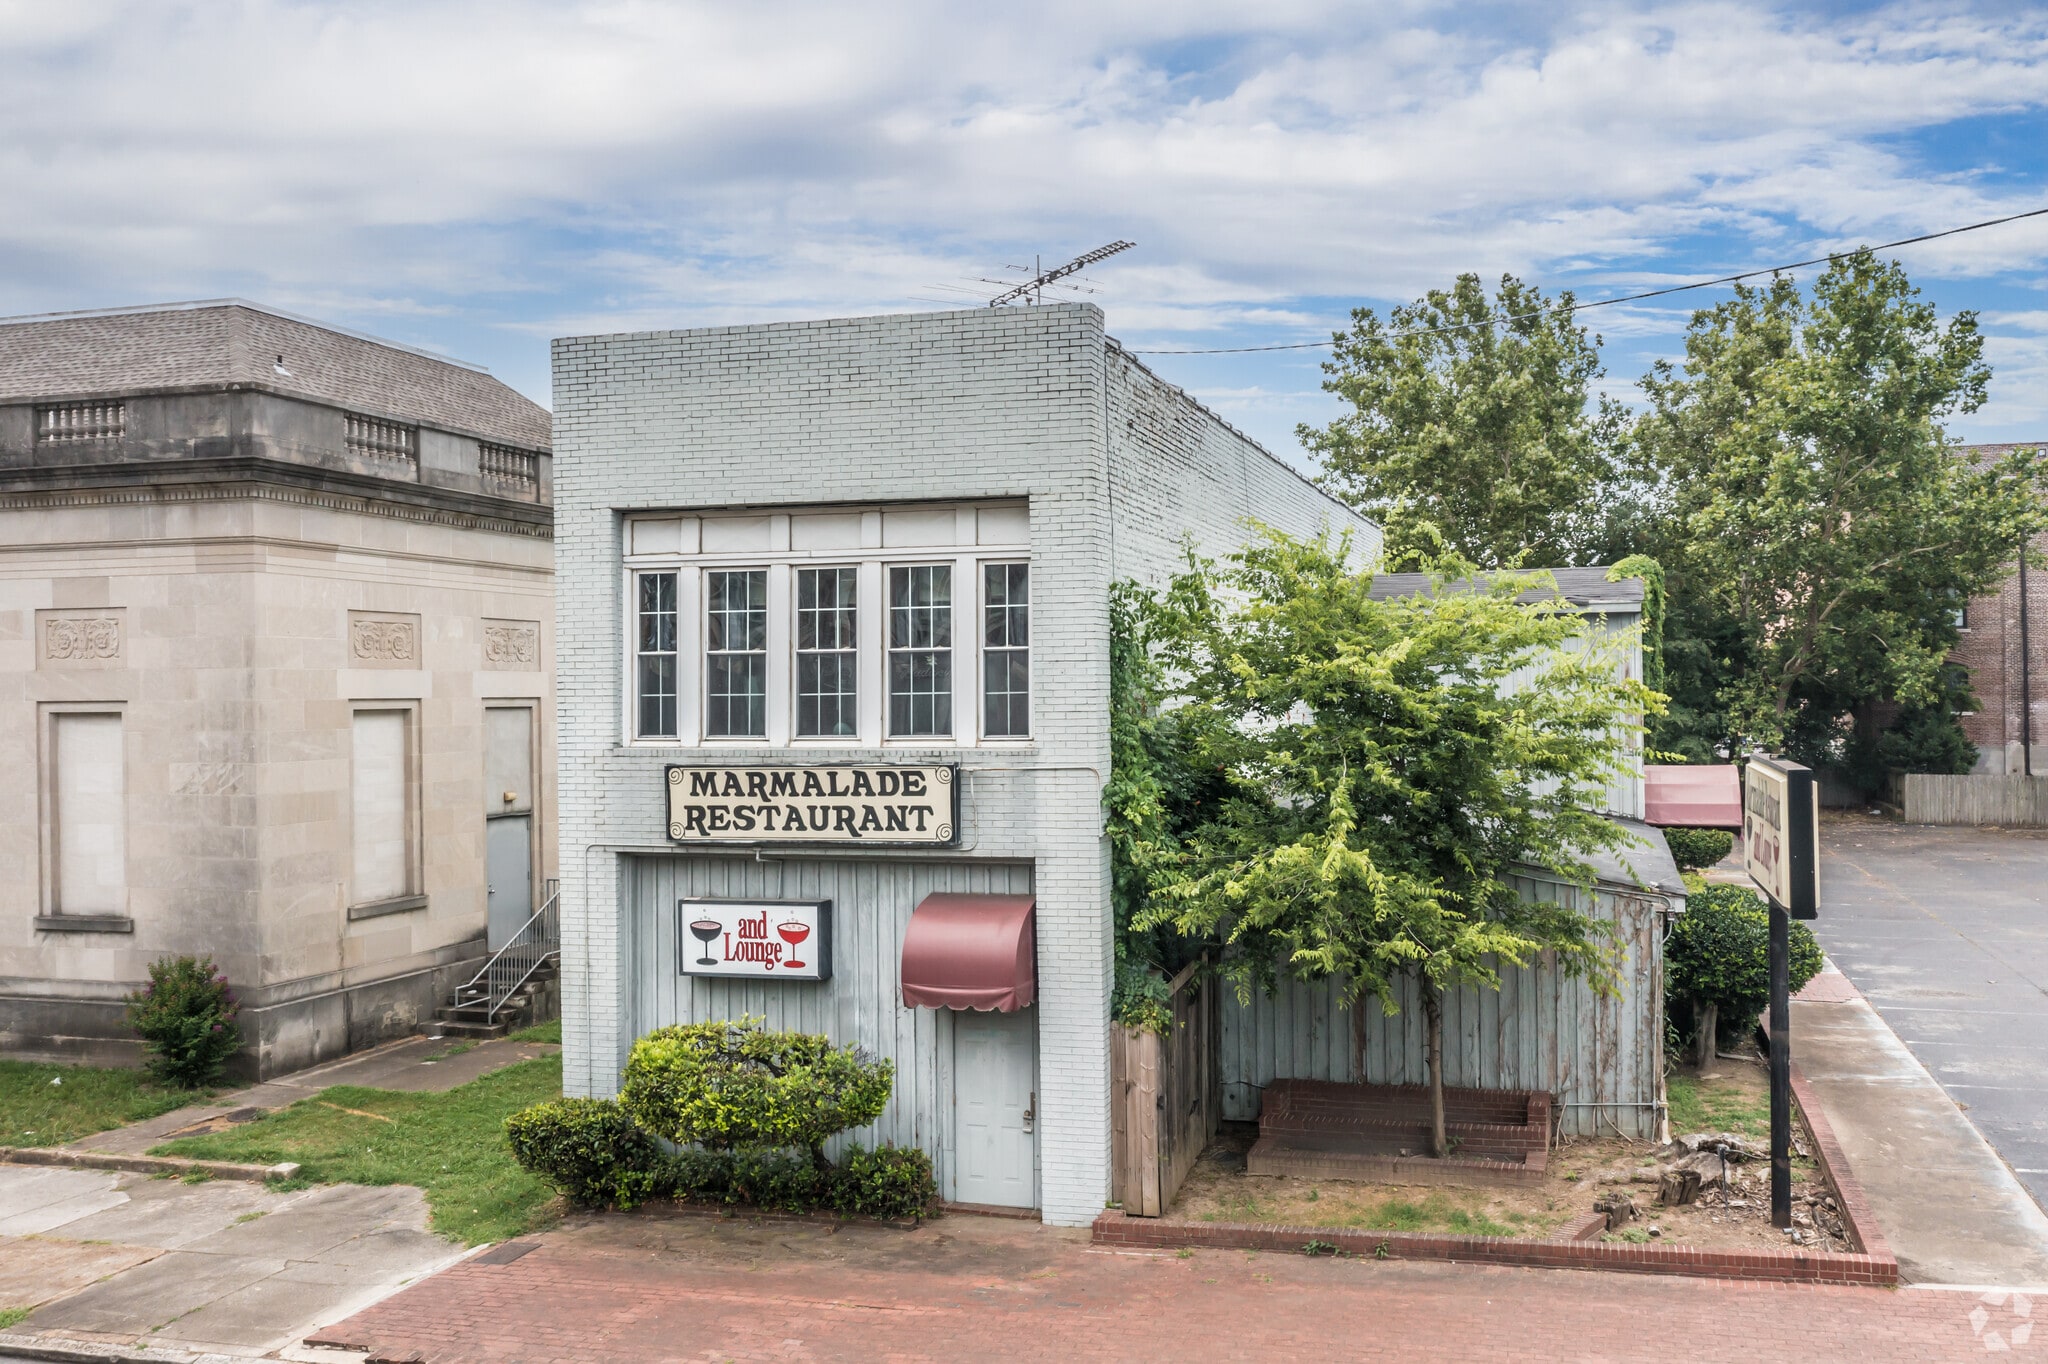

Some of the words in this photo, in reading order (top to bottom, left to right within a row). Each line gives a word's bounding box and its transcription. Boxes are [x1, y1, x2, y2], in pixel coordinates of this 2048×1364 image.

[689, 769, 928, 803] MARMALADE
[684, 804, 934, 838] RESTAURANT
[738, 911, 768, 939] and
[724, 932, 783, 971] Lounge
